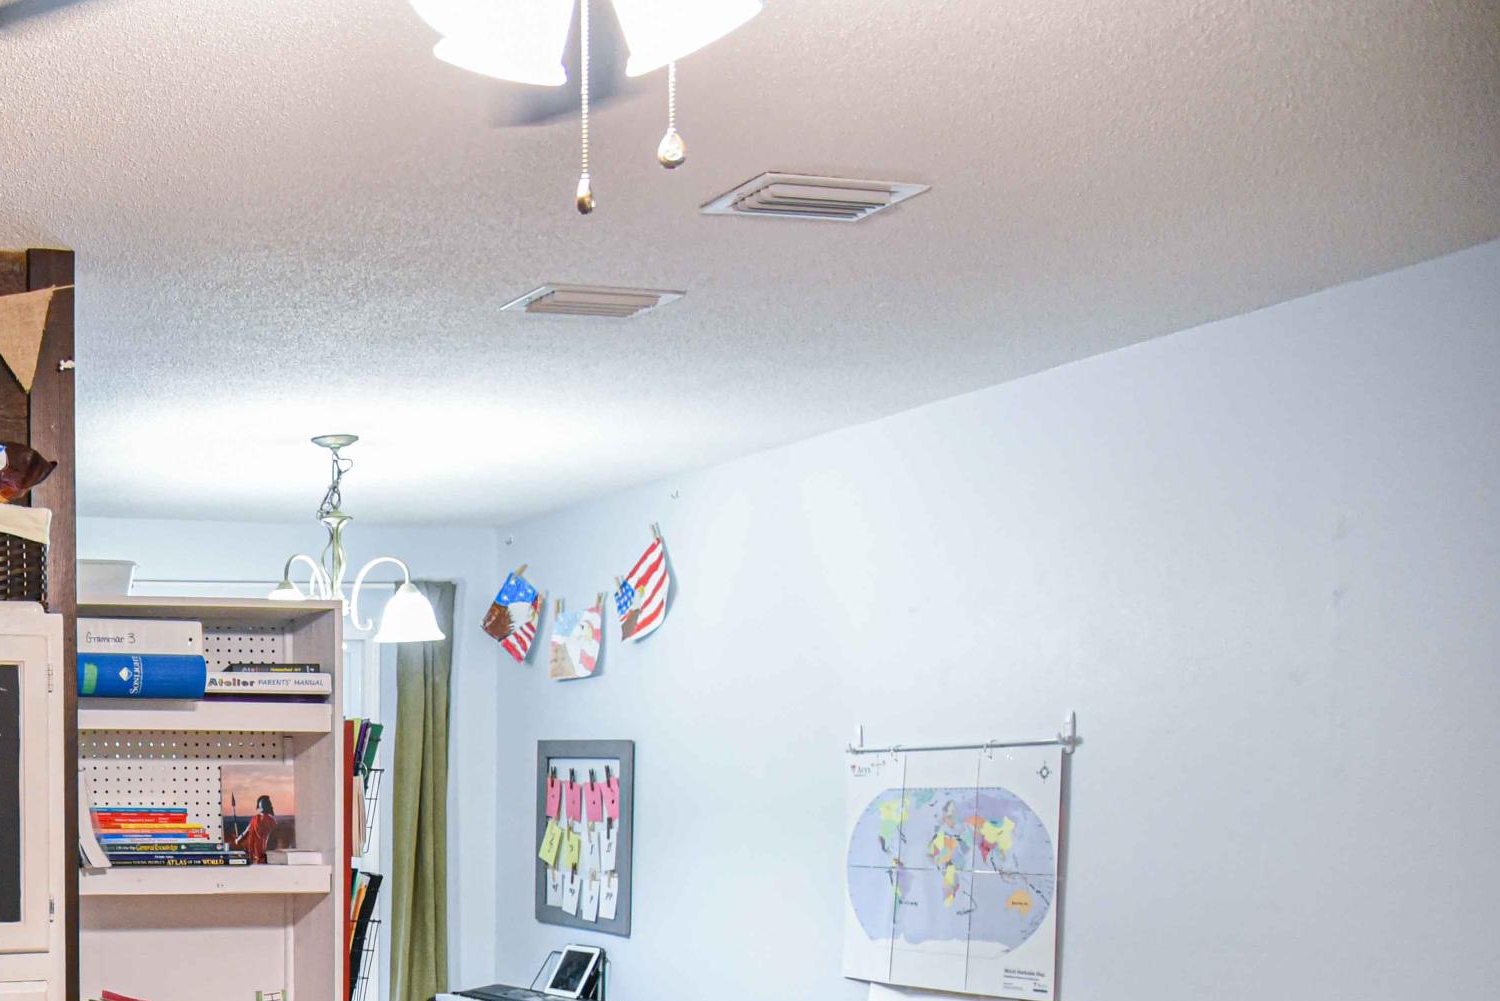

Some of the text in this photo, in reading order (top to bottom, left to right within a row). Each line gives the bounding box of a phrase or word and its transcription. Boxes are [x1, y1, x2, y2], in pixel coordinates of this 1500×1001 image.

[127, 632, 136, 644] 3
[207, 677, 256, 688] Atelier
[293, 679, 325, 687] MANUAL
